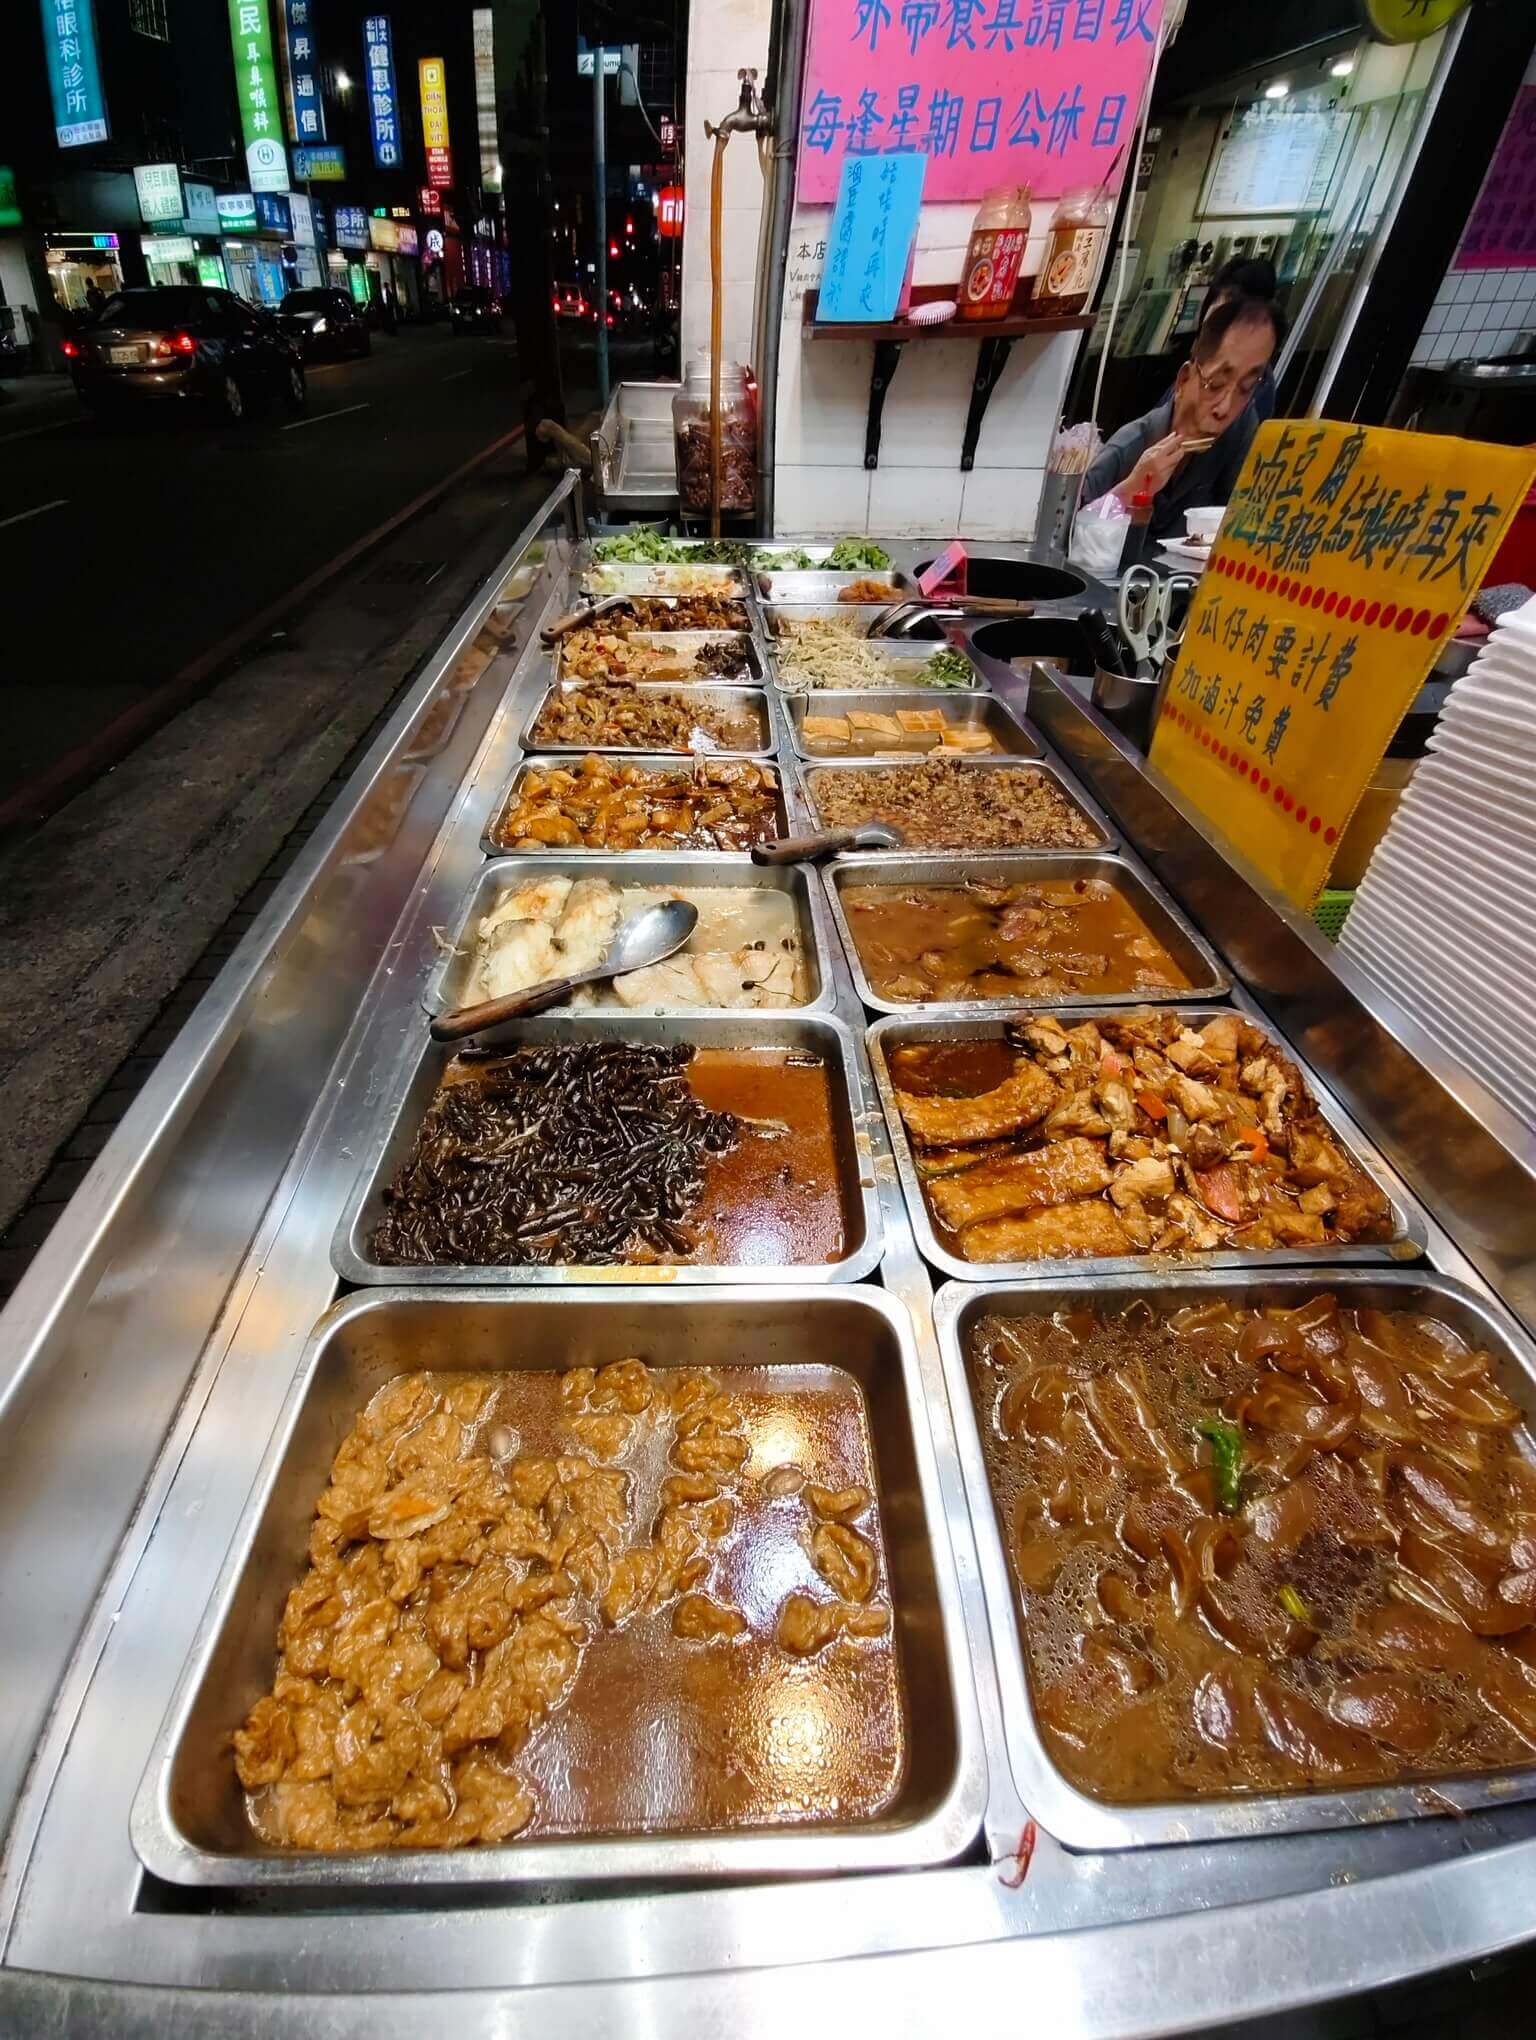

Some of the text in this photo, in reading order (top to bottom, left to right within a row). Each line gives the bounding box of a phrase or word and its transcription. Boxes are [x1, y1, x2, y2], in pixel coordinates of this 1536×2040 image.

[802, 84, 1128, 156] 每逢星期日公休日
[1196, 597, 1360, 712] 瓜仔肉要計費
[1177, 659, 1292, 766] 加滷汁免費
